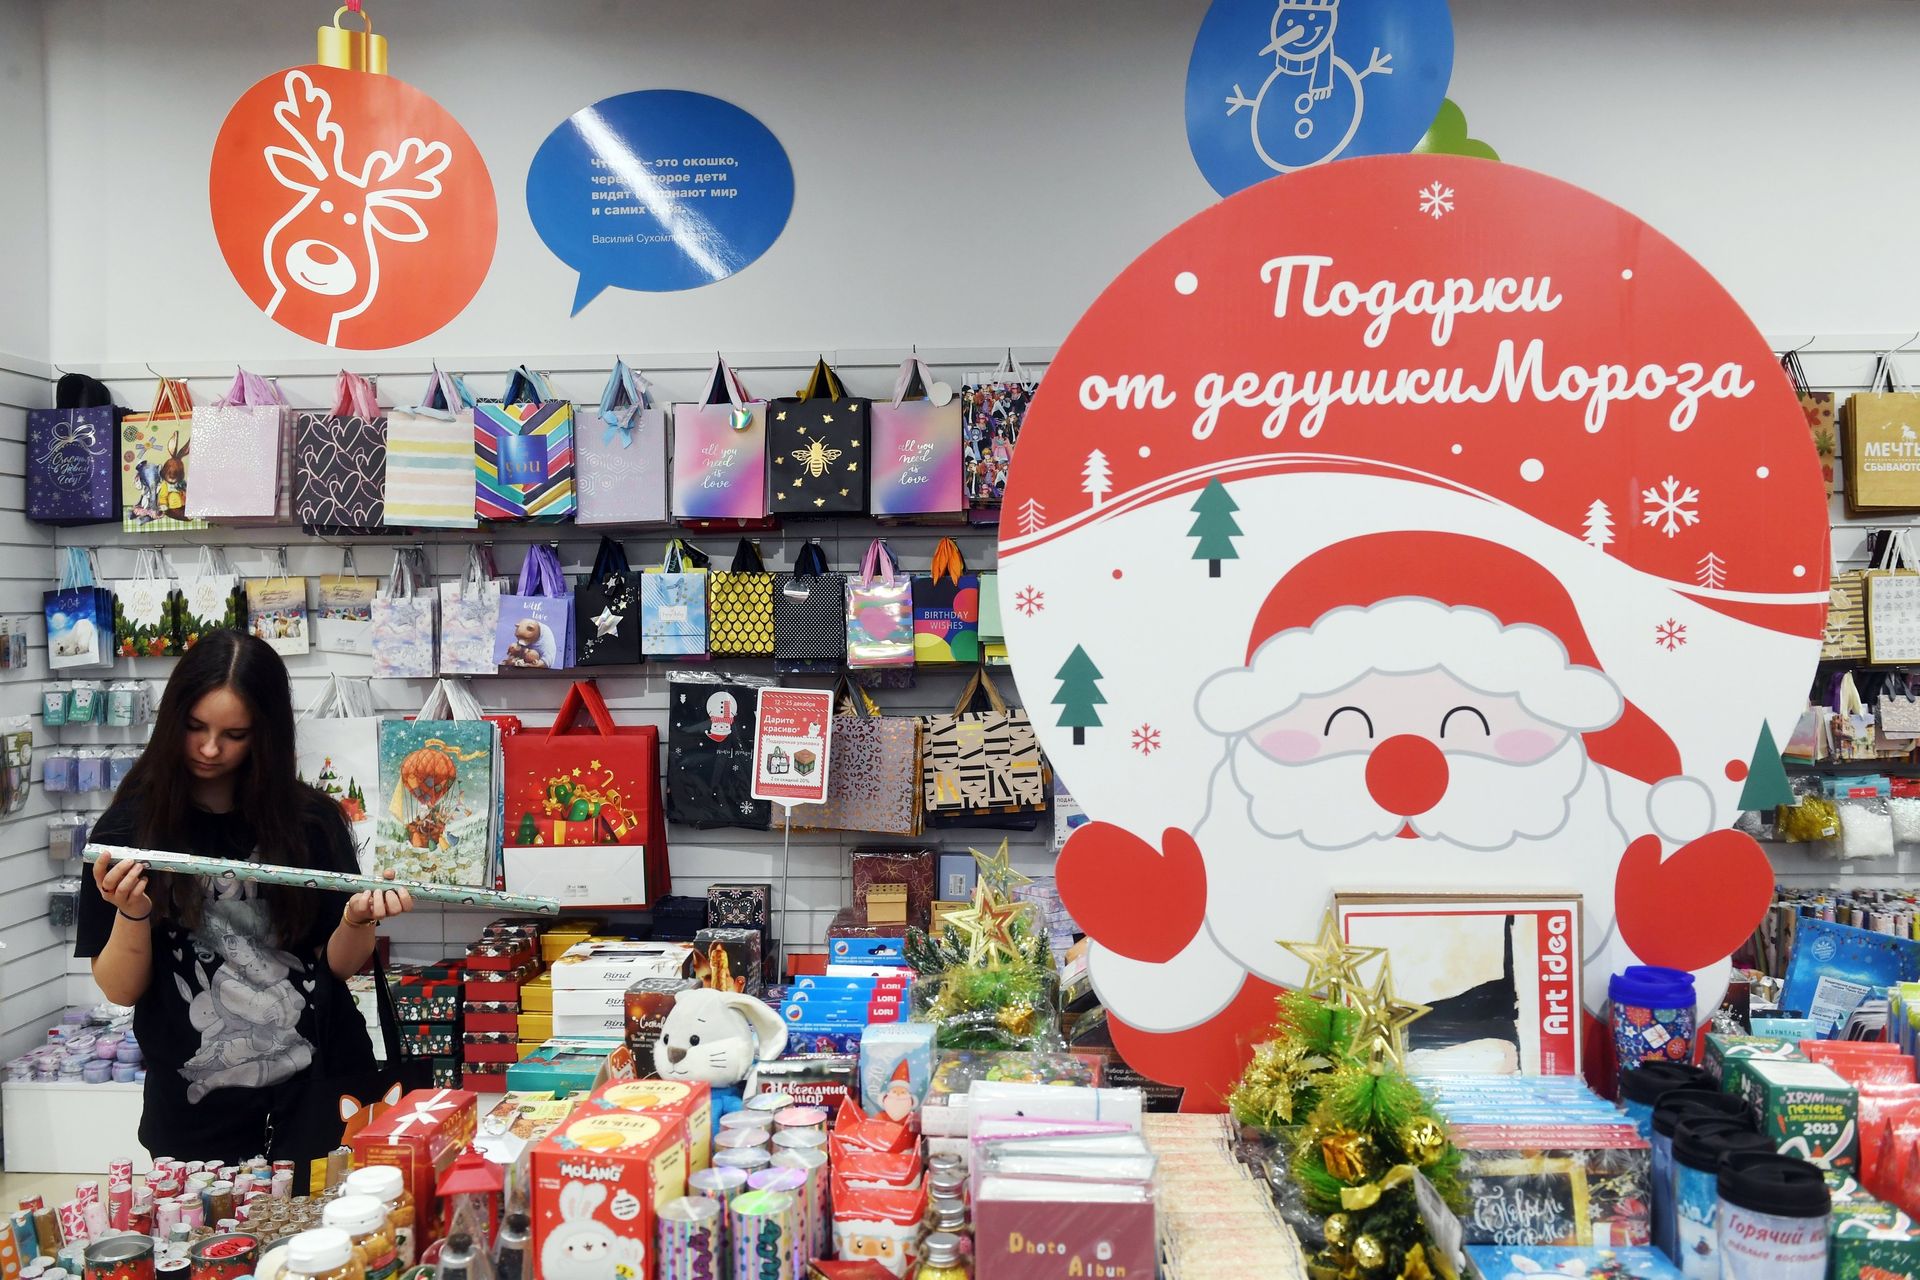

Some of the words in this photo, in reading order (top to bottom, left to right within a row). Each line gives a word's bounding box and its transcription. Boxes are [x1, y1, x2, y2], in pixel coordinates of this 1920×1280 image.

[655, 158, 678, 167] это
[683, 156, 739, 167] окошко,
[695, 171, 727, 183] дети
[592, 191, 630, 201] видят
[711, 187, 738, 199] мир
[592, 207, 600, 215] и
[604, 205, 645, 215] самих
[592, 234, 634, 244] Василий
[1261, 255, 1563, 348] Подарки
[1079, 373, 1177, 411] от
[1192, 368, 1466, 440] дедушки
[1460, 338, 1756, 434] Мороза
[701, 443, 718, 455] all
[721, 448, 737, 458] you
[898, 439, 915, 451] all
[917, 443, 934, 453] you
[702, 455, 735, 467] need
[898, 449, 932, 463] need
[505, 461, 541, 478] you
[701, 475, 732, 488] love
[898, 471, 929, 485] love
[523, 602, 543, 611] with
[532, 611, 547, 620] love
[924, 611, 968, 619] BIRTHDAY
[931, 621, 963, 629] WISHES
[764, 715, 795, 725] Дарите
[1541, 915, 1568, 982] idea
[603, 971, 631, 979] Bind
[1543, 989, 1569, 1035] Art
[765, 1080, 848, 1095] Новогодний
[1803, 1122, 1838, 1135] 2023
[1728, 1214, 1804, 1245] Горячий
